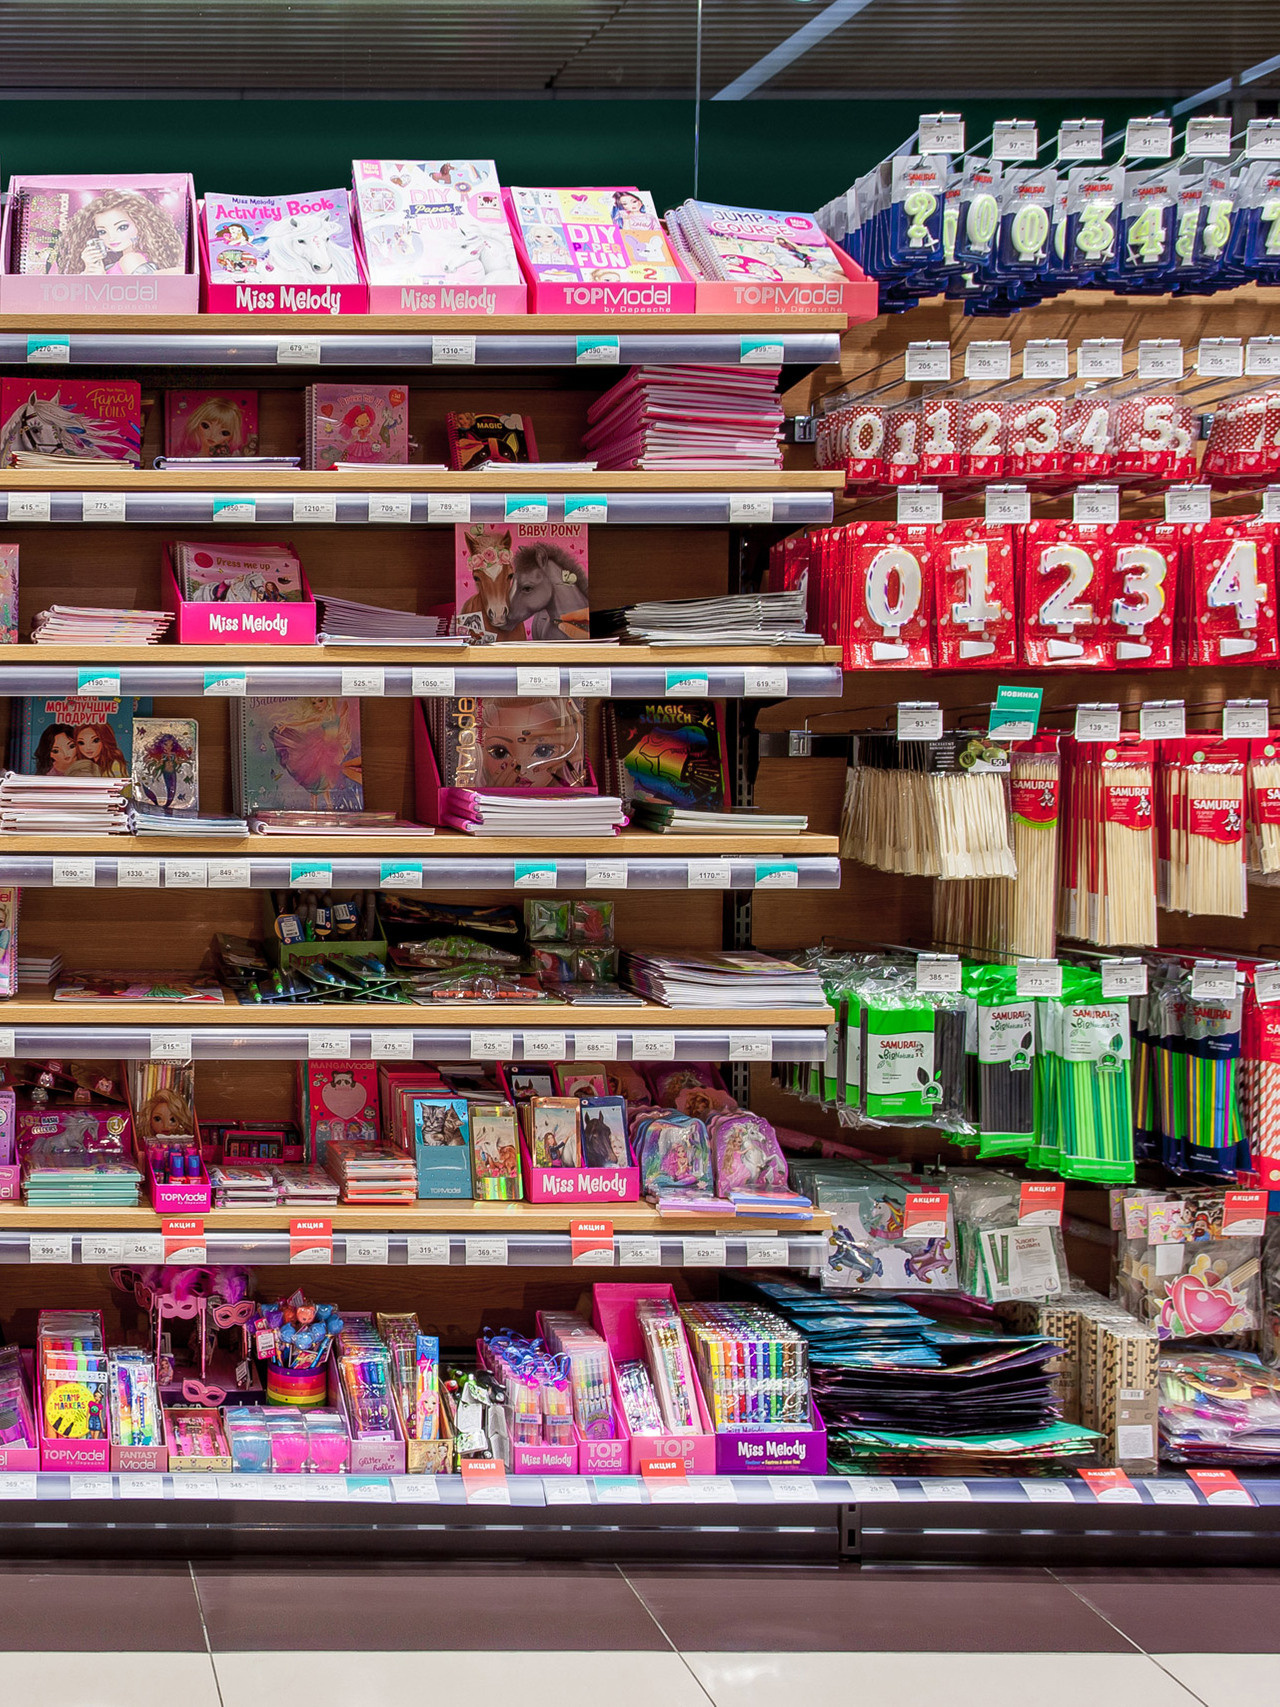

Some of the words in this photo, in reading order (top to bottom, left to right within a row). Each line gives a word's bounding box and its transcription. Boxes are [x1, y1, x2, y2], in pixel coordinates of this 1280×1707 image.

[410, 188, 450, 203] DIY
[216, 203, 282, 221] Activity
[286, 197, 335, 215] Book
[415, 203, 453, 215] Paper
[714, 209, 764, 223] JUMP
[417, 217, 457, 230] FUN
[712, 220, 794, 237] COURSE
[566, 224, 616, 244] DIY
[573, 242, 622, 254] PAPER
[576, 251, 628, 269] FUN
[643, 267, 658, 280] 2
[41, 281, 157, 302] TOPModel
[564, 286, 671, 305] TOPModel
[733, 285, 843, 305] TOPModel
[236, 287, 274, 309] Miss
[280, 286, 341, 314] Melody
[401, 289, 436, 312] Miss
[440, 289, 496, 313] Melody
[86, 387, 134, 411] Fancy
[99, 405, 126, 418] FOILS
[477, 422, 502, 430] MAGIC
[519, 524, 547, 537] BABY
[551, 524, 581, 537] PONY
[866, 545, 922, 628] 0
[951, 544, 1001, 623] 1
[1038, 546, 1094, 625] 2
[1112, 545, 1167, 626] 3
[209, 613, 238, 632] Miss
[242, 613, 288, 636] Melody
[1001, 690, 1039, 699] НОВИНКА
[74, 701, 118, 714] ЛУЧШИЕ
[645, 704, 684, 716] MAGIC
[56, 712, 106, 724] ПОДРУГИ
[1012, 781, 1054, 790] SAMURAI
[1110, 787, 1149, 796] SAMURAI
[1193, 800, 1240, 810] SAMURAI
[991, 1012, 1025, 1022] SAMURAI
[1073, 1009, 1111, 1018] SAMURAI
[1193, 1007, 1231, 1019] SAMURAI
[880, 1040, 917, 1050] SAMURAI
[542, 1174, 574, 1193] Miss
[578, 1173, 627, 1197] Melody
[160, 1192, 208, 1202] TOPModel
[58, 1393, 81, 1403] STAMP
[53, 1401, 86, 1411] MARKERS
[587, 1443, 623, 1458] TOP
[653, 1440, 695, 1457] TOP
[738, 1441, 764, 1458] Miss
[766, 1440, 807, 1459] Melody
[43, 1449, 106, 1462] TOPModel
[119, 1451, 158, 1460] FANTASY
[521, 1453, 541, 1466] Miss
[542, 1453, 572, 1468] Melody
[119, 1459, 157, 1470] Model
[468, 1462, 495, 1470] АКЦИЯ
[587, 1458, 622, 1468] Model
[649, 1461, 677, 1470] АКЦИЯ
